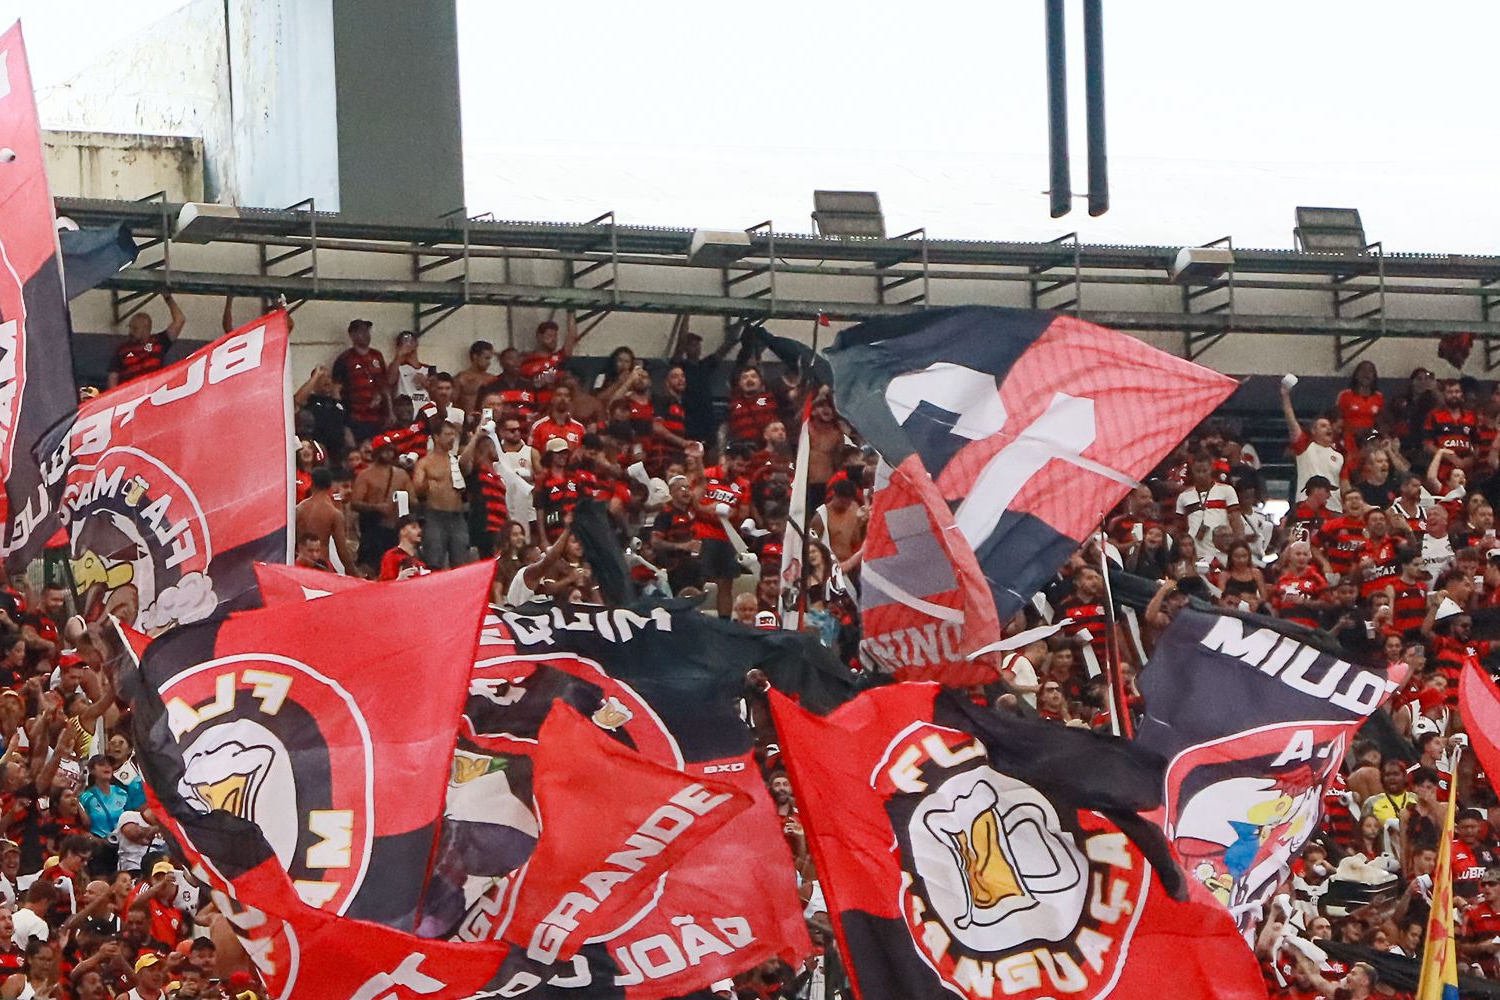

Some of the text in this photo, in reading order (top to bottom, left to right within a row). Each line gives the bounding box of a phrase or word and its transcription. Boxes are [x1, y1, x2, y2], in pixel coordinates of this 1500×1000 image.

[703, 761, 745, 775] BXD
[527, 782, 733, 965] GRANDE
[614, 914, 756, 986] JOÃO
